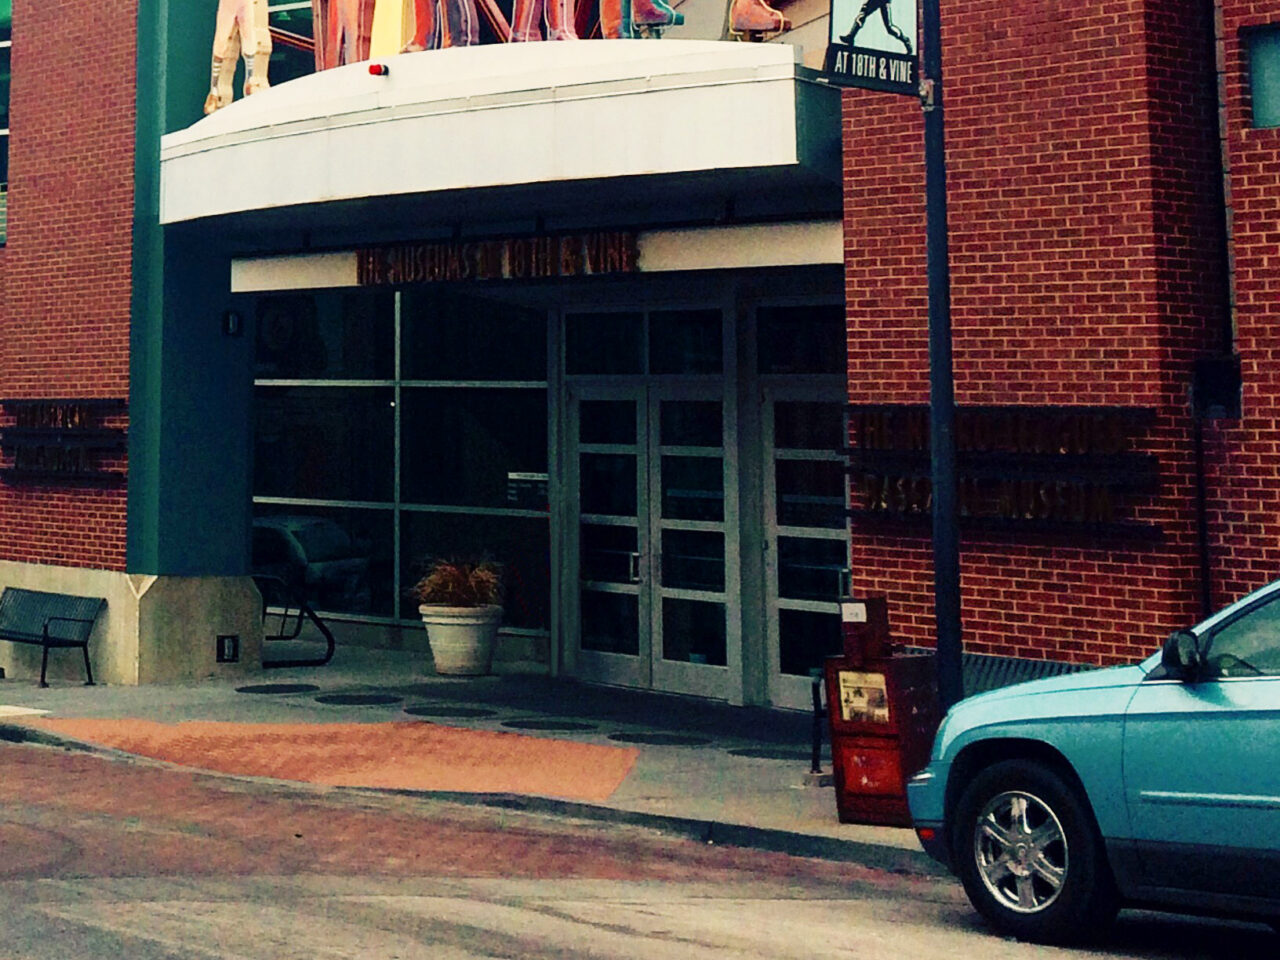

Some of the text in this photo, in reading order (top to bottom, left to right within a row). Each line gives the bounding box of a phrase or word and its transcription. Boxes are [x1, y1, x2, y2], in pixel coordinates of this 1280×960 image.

[834, 50, 913, 84] AT 18TH & VINE
